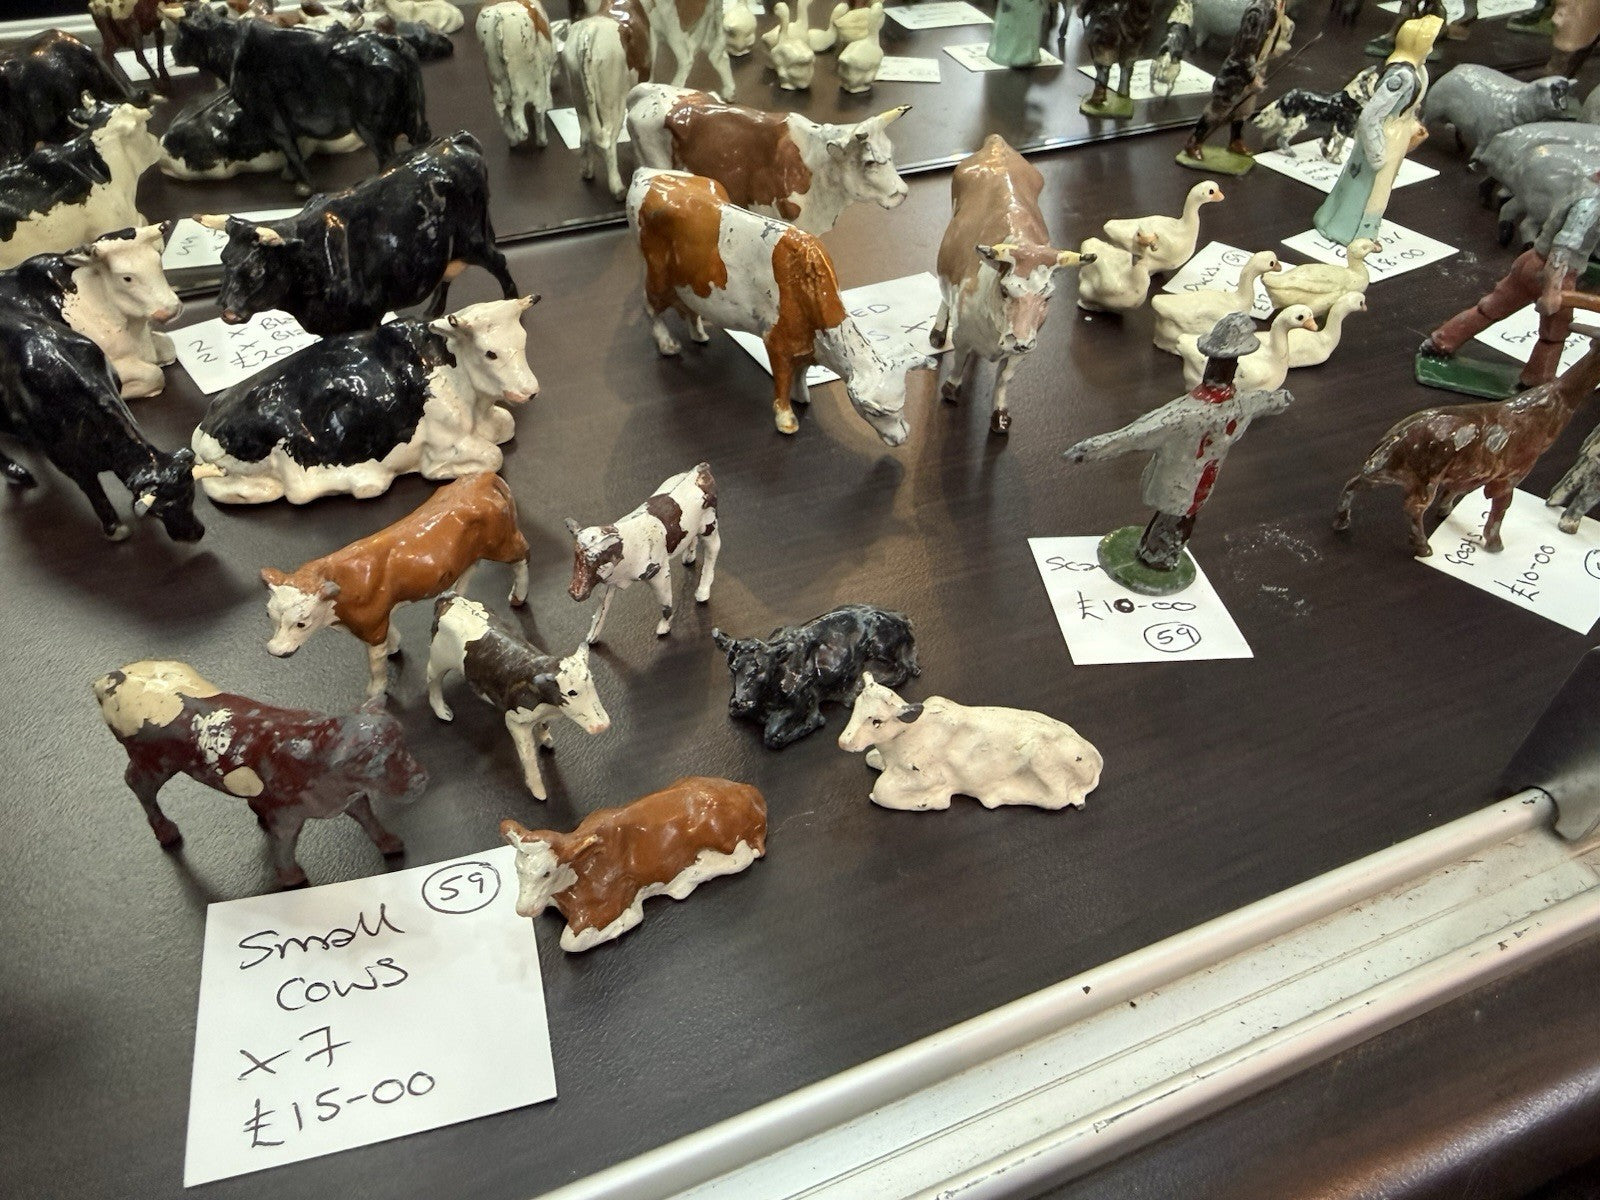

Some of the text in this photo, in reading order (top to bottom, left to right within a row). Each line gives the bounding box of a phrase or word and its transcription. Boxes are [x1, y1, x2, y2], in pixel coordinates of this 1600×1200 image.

[1494, 544, 1556, 602] £10-00
[1077, 590, 1197, 621] £10-00
[1156, 627, 1196, 645] 59
[437, 871, 486, 902] 59
[238, 902, 406, 970] Small
[243, 1070, 437, 1149] £15-00
